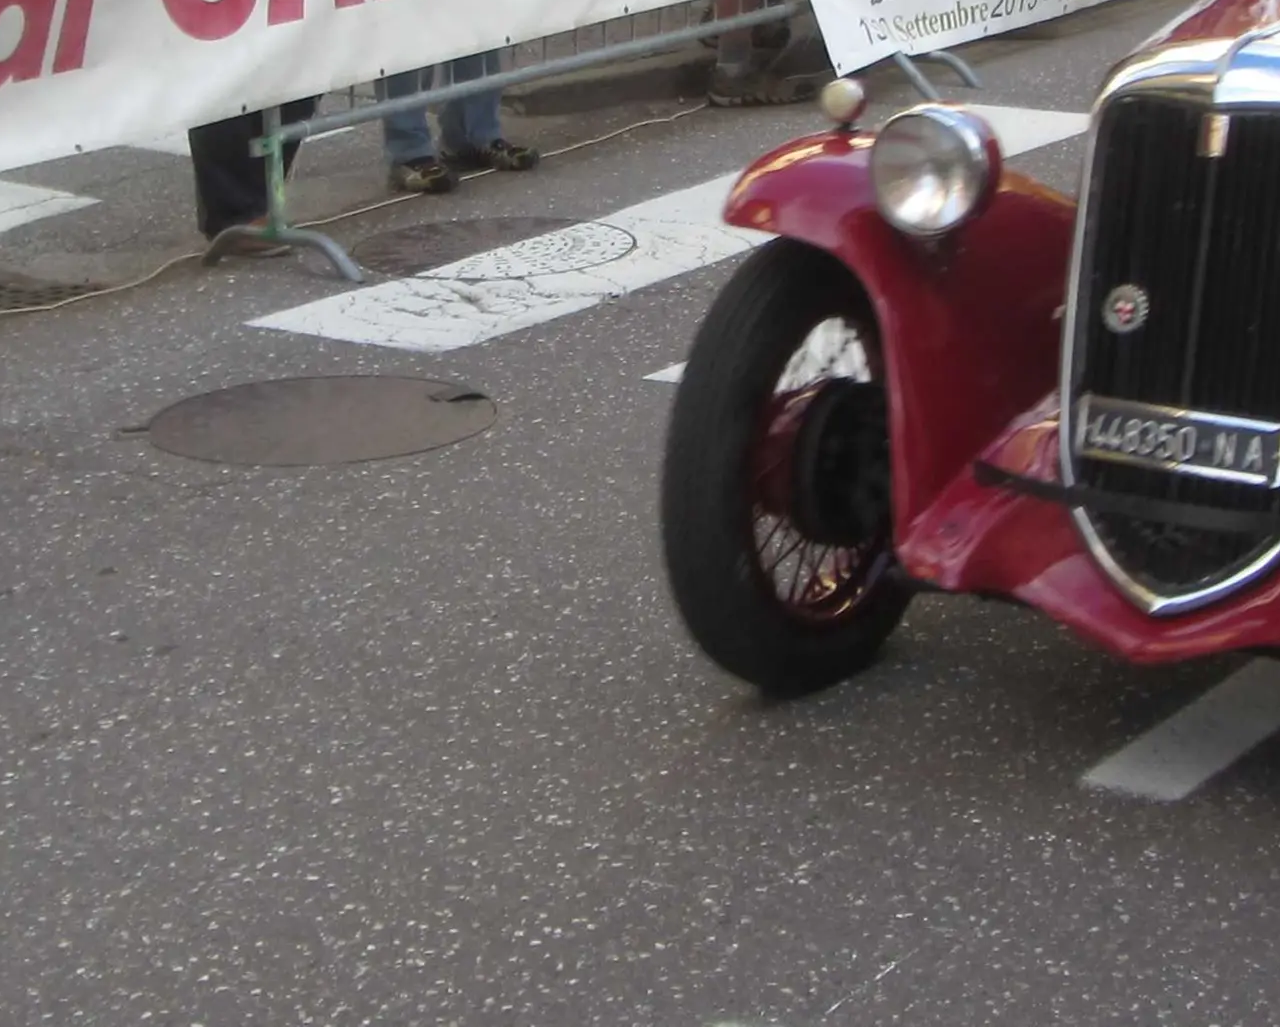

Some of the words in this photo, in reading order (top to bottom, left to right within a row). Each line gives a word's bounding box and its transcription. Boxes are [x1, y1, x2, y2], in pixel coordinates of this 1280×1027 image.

[891, 0, 989, 43] Settembre
[1088, 412, 1198, 463] 448350
[1213, 431, 1263, 472] NA
